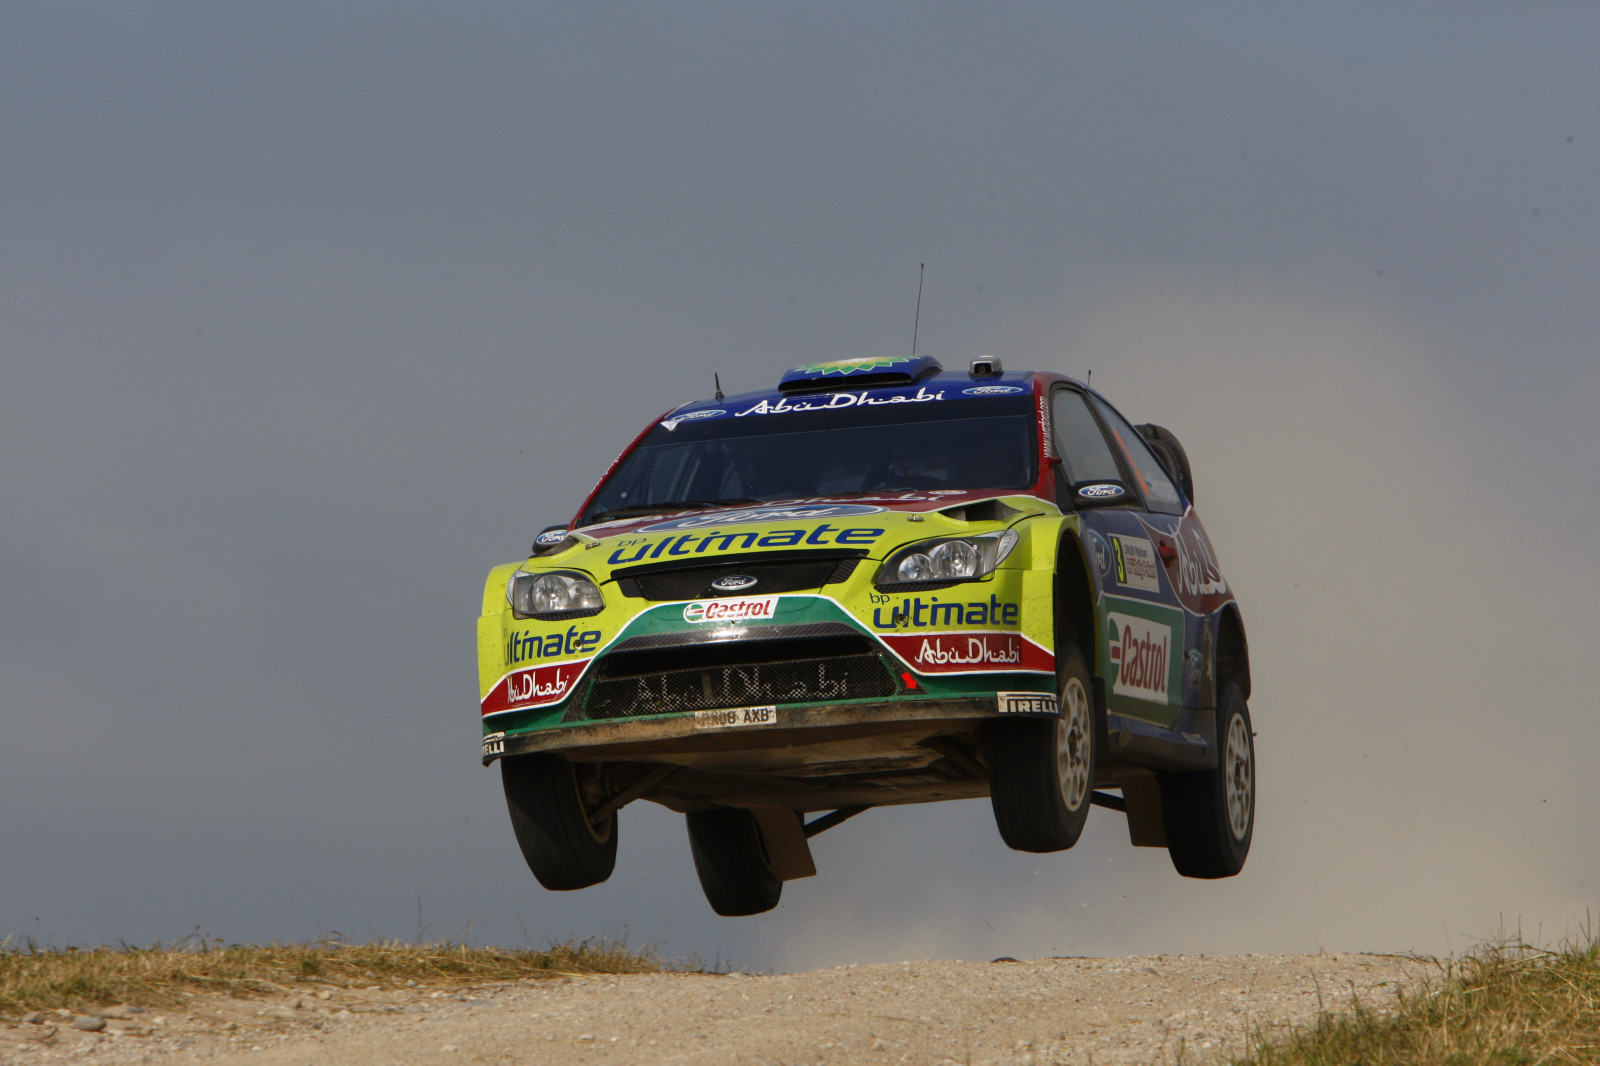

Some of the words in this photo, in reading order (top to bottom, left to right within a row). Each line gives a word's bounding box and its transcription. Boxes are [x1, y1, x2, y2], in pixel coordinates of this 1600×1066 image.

[1088, 485, 1117, 496] Ford
[677, 506, 841, 528] Ford
[607, 524, 886, 565] ultimate
[1113, 537, 1124, 582] 3
[720, 577, 746, 586] Ford
[705, 599, 771, 619] Castrol
[869, 593, 891, 606] bp
[873, 594, 1019, 629] ultimate
[1121, 624, 1167, 694] Castrol
[997, 691, 1059, 714] PIRELLI
[743, 707, 770, 724] AXB
